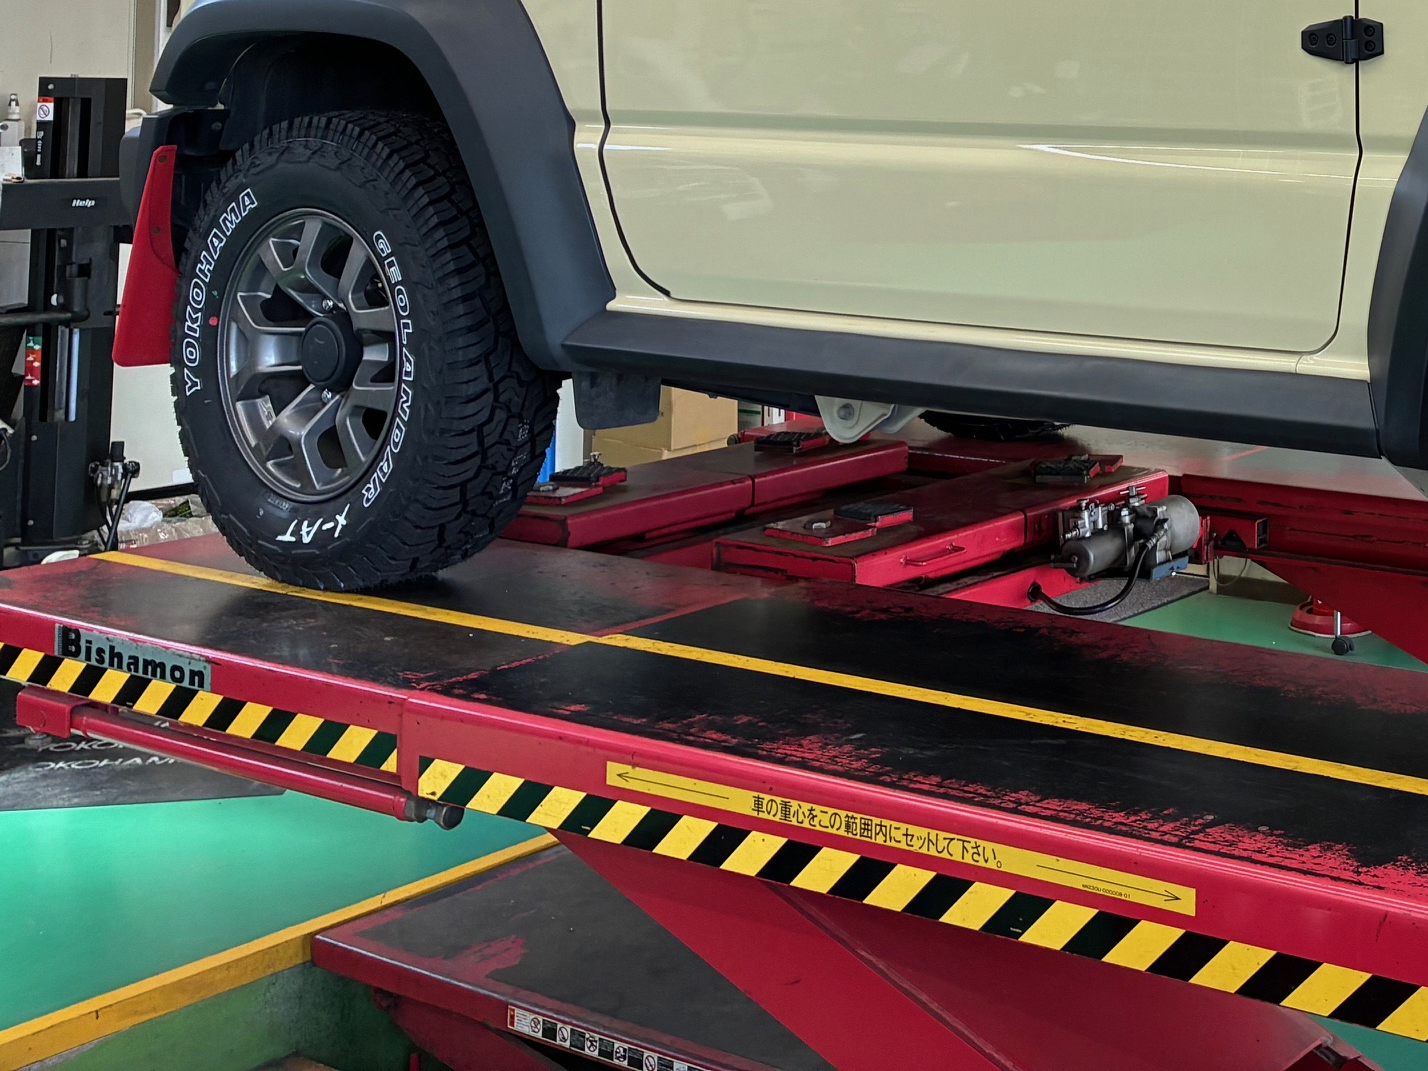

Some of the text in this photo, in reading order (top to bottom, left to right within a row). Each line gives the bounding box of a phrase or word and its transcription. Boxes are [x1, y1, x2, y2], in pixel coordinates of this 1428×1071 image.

[183, 187, 259, 396] YOKOHAMA
[276, 230, 415, 544] GEOLANDAR X-AT
[60, 626, 206, 689] Bishamon
[751, 794, 1003, 869] 車の重心をこの範囲内にセットして下さい。
